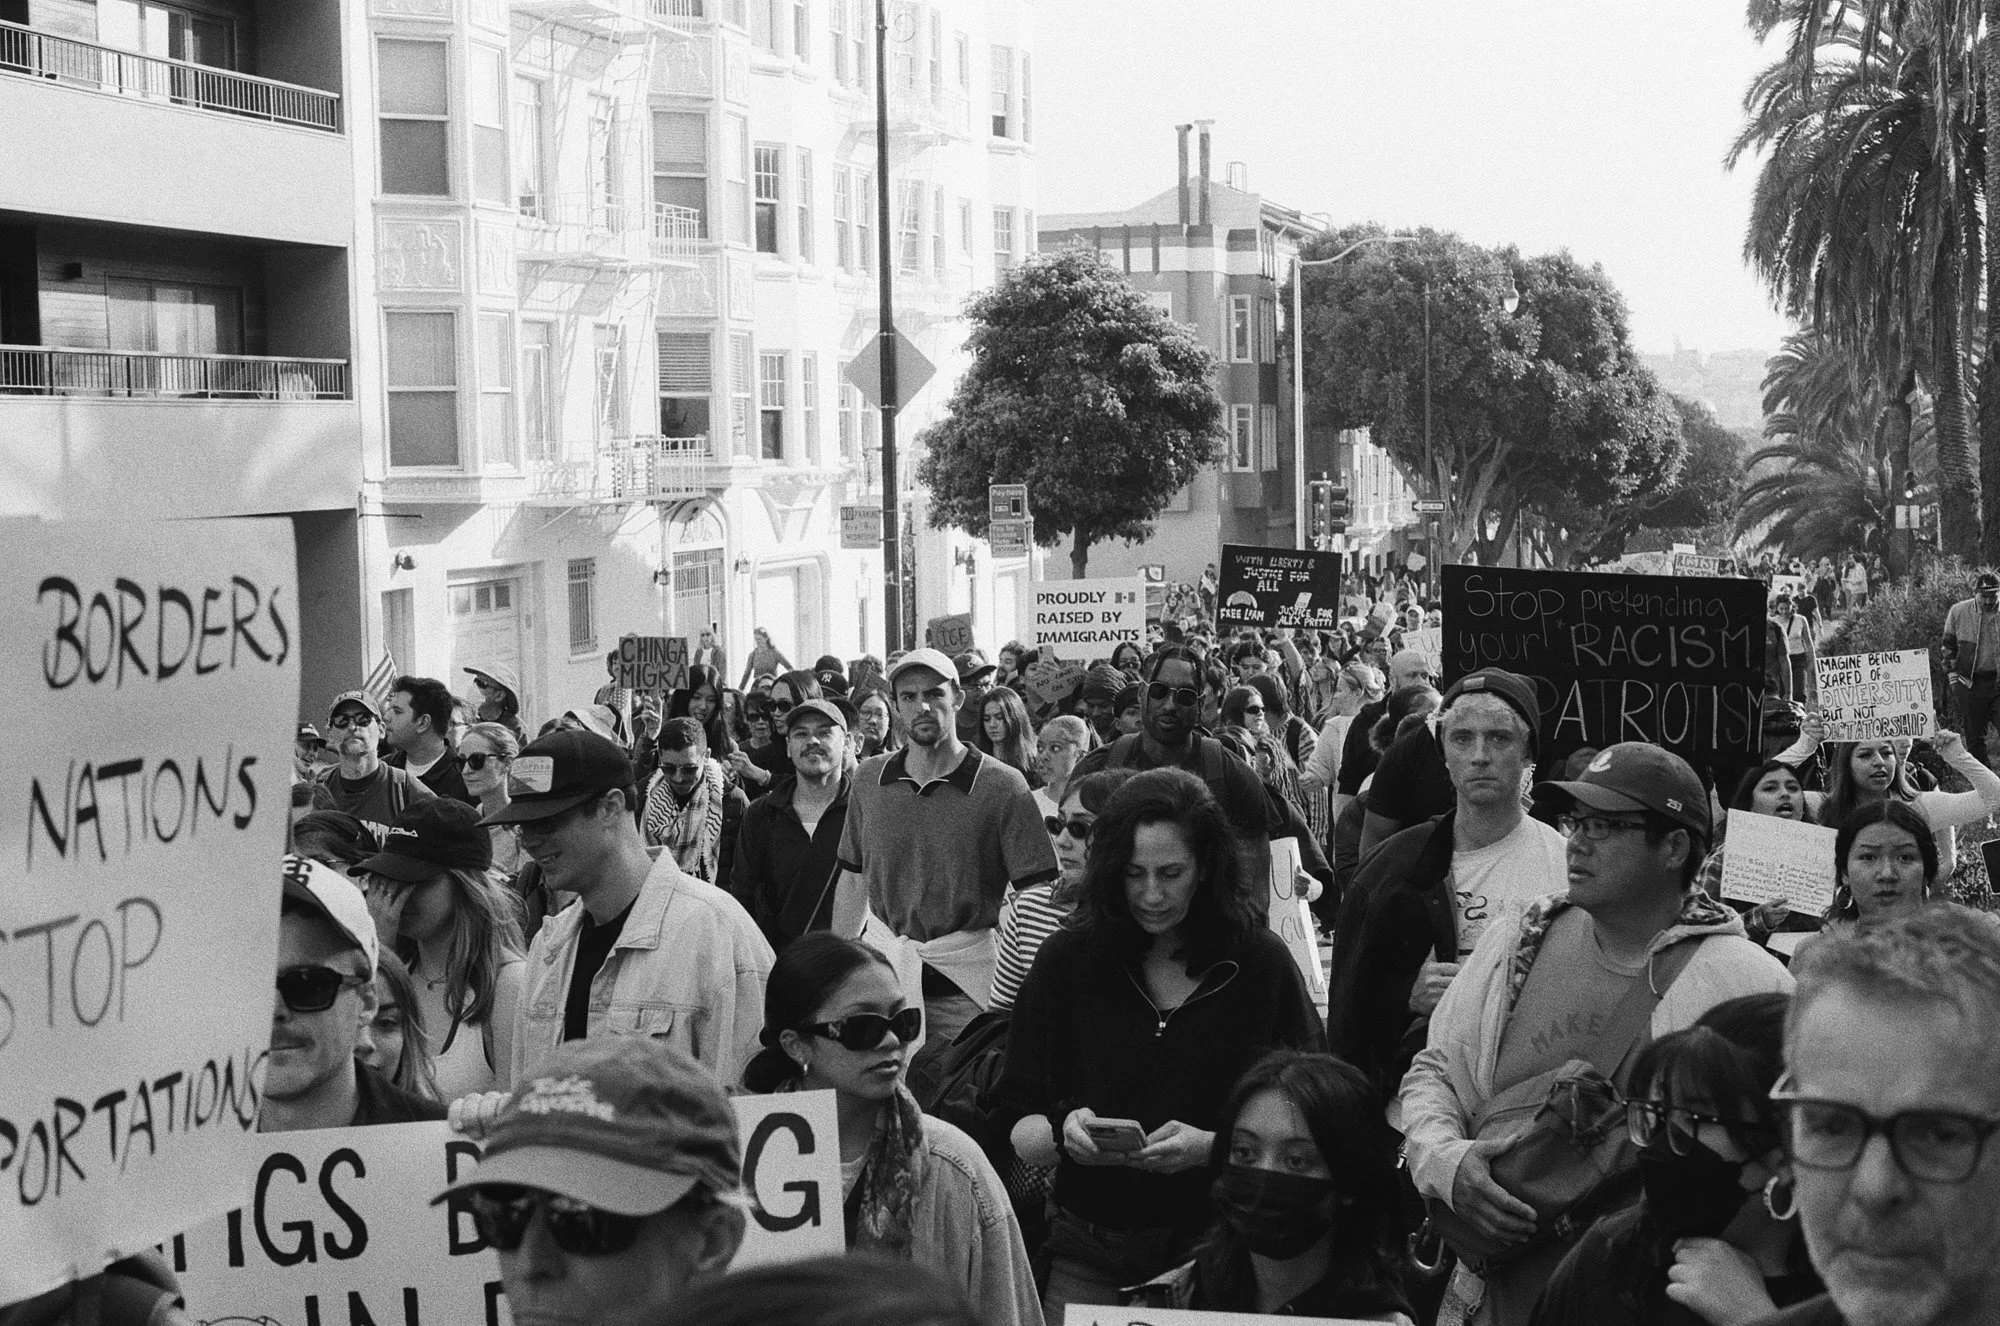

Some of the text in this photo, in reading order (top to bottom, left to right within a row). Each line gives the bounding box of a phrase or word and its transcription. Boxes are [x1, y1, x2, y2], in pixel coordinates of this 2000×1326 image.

[1235, 555, 1316, 569] WITH LIBERTY &
[1676, 555, 1719, 572] RESIST
[1243, 566, 1310, 582] JUSTICE FOR
[1256, 580, 1280, 592] ALL
[1036, 591, 1106, 605] PROUDLY
[1036, 611, 1122, 625] RAISED BY
[1220, 607, 1242, 620] FREE
[1278, 605, 1334, 619] JUSTICE FOR
[1278, 615, 1301, 625] ALEX
[1465, 574, 1730, 647] Stop pretending
[38, 574, 290, 690] BORDERS
[938, 627, 967, 648] ICE
[1036, 629, 1140, 644] IMMIGRANTS
[621, 637, 689, 667] CHINGA
[1459, 630, 1541, 671] your
[1817, 652, 1901, 673] IMAGINE BEING
[621, 662, 689, 689] MIGRA
[1820, 667, 1881, 690] SCARED OF
[1821, 678, 1929, 708] DIVERSITY
[1822, 705, 1878, 722] BUT NOT
[1823, 712, 1928, 741] DICTATORSHIP
[26, 743, 258, 872] NATIONS
